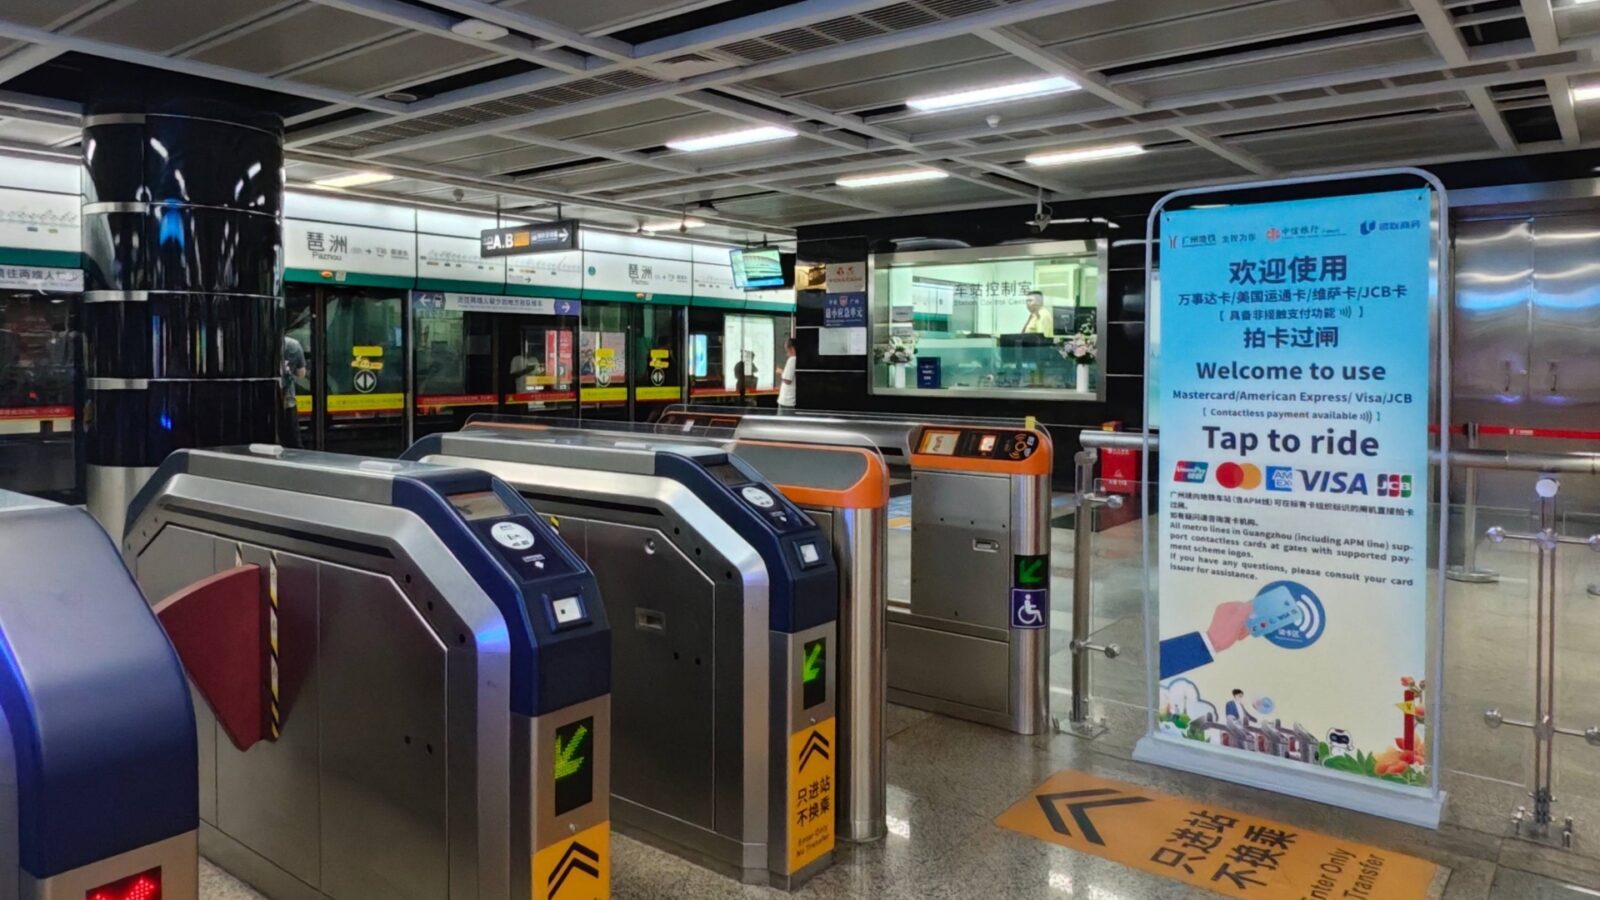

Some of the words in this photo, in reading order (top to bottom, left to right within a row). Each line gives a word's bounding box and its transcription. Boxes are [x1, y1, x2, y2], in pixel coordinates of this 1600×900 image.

[306, 231, 348, 254] 琶洲
[1228, 254, 1347, 286] 欢迎使用
[954, 280, 1032, 298] 车站控制室
[1177, 284, 1408, 306] 万事达卡/美国运通卡/维萨卡/JCB卡
[1243, 326, 1339, 349] 拍卡过闸
[1196, 361, 1303, 381] Welcome
[1309, 363, 1335, 381] to
[1341, 365, 1387, 381] use
[1172, 390, 1296, 403] Mastercard/American
[1299, 391, 1353, 405] Express/
[1355, 392, 1413, 405] Visa/JCB
[1210, 408, 1265, 419] Contactless
[1266, 410, 1310, 422] payment
[1311, 410, 1357, 421] available
[1202, 426, 1258, 456] Tap
[1268, 429, 1301, 453] to
[1310, 428, 1380, 457] ride
[1295, 469, 1369, 496] VISA
[1182, 523, 1208, 532] metro
[1210, 525, 1230, 534] lines
[1243, 529, 1293, 540] Guangzhou
[1294, 533, 1342, 546] (including
[1343, 538, 1365, 547] APM
[1170, 543, 1192, 551] ment
[1193, 545, 1226, 555] scheme
[1227, 549, 1254, 559] logos.
[1191, 535, 1240, 546] contactless
[1243, 540, 1267, 549] cards
[1270, 542, 1280, 550] at
[1283, 544, 1308, 553] gates
[1311, 546, 1333, 556] with
[1336, 549, 1387, 561] supported
[1170, 562, 1195, 573] issuer
[1196, 564, 1210, 574] for
[1211, 568, 1259, 581] assistance.
[1179, 554, 1195, 562] you
[1198, 555, 1219, 565] have
[1222, 559, 1238, 569] any
[1241, 561, 1288, 574] questions,
[1291, 566, 1321, 577] please
[1324, 570, 1361, 581] consult
[1363, 575, 1387, 584] your
[1391, 578, 1414, 587] card
[796, 774, 831, 808] 只进站
[1150, 810, 1239, 875] 只进站
[1210, 825, 1299, 890] 不换乘
[1319, 846, 1357, 874] Only
